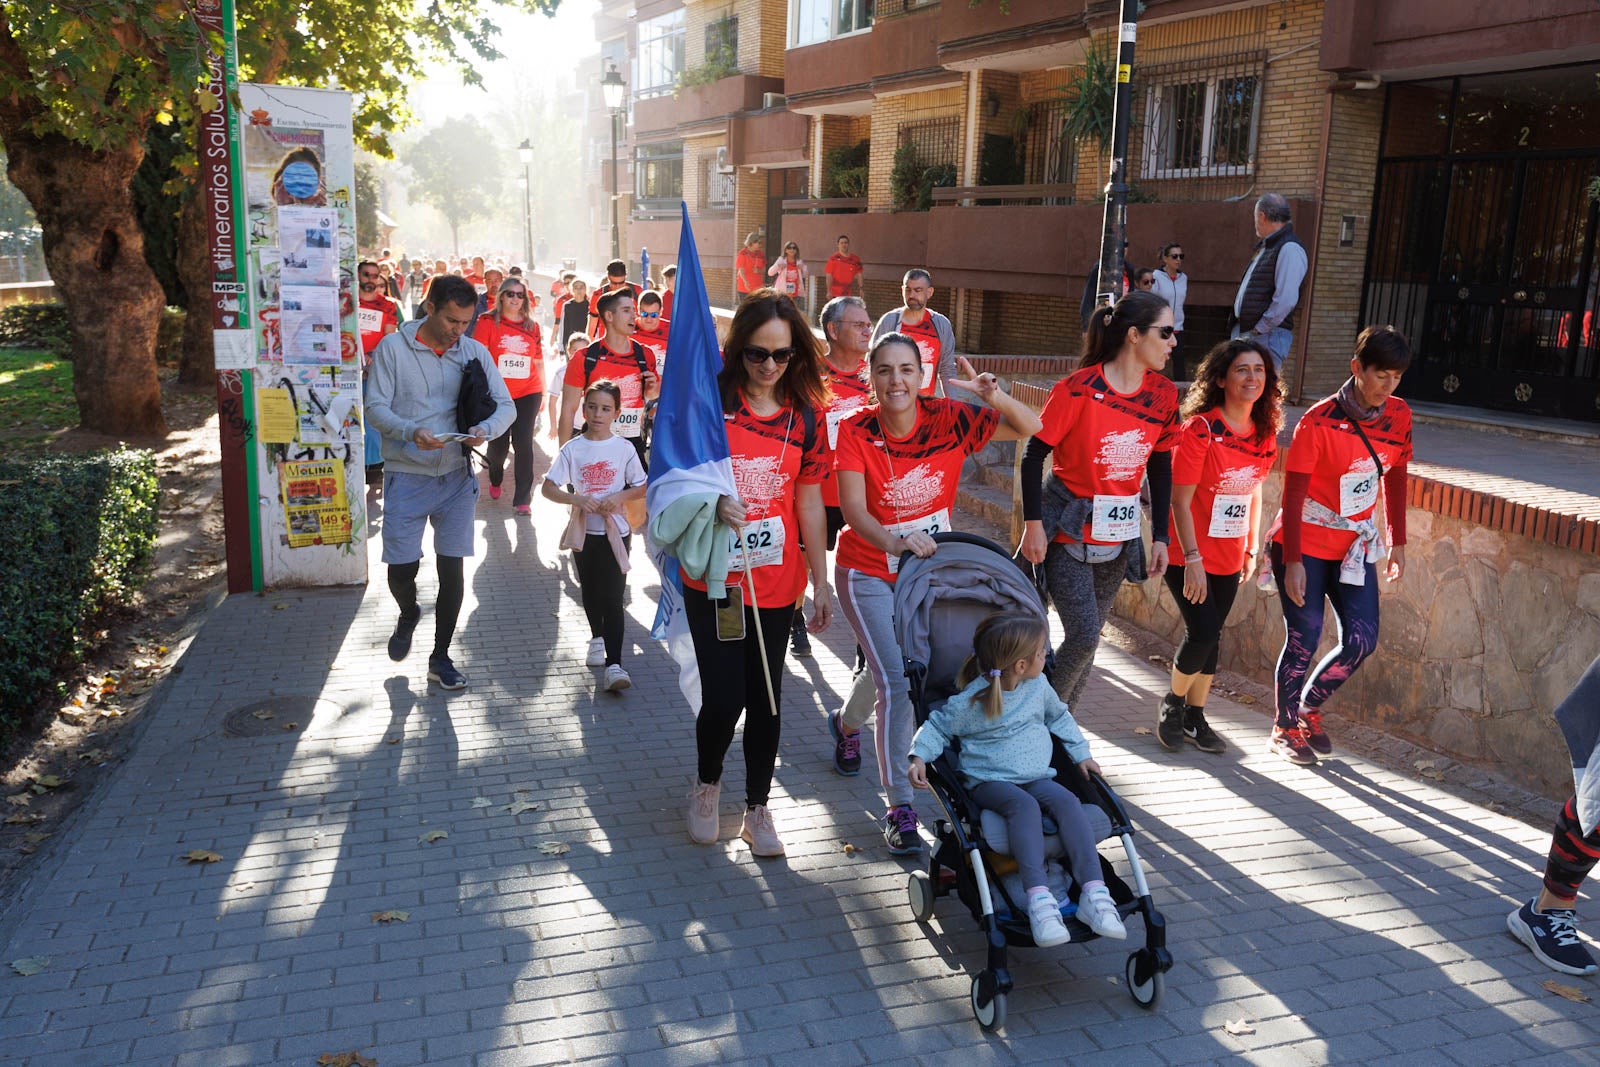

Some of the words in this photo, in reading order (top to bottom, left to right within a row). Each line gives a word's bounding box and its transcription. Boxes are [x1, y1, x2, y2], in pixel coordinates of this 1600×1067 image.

[206, 47, 228, 158] Saluable
[302, 120, 347, 129] Ayuntamiento
[231, 124, 239, 141] Ruta
[1519, 127, 1530, 145] 2
[209, 164, 232, 263] Itinerarios
[215, 284, 244, 292] MPS
[359, 313, 377, 321] 1256
[504, 360, 525, 368] 1549
[615, 414, 638, 424] 009
[1101, 444, 1148, 456] carrera
[288, 464, 334, 476] MOLINA
[733, 470, 784, 487] arrera
[1353, 476, 1372, 494] 43
[1108, 506, 1134, 520] 436
[1225, 505, 1246, 518] 429
[320, 514, 338, 525] 149
